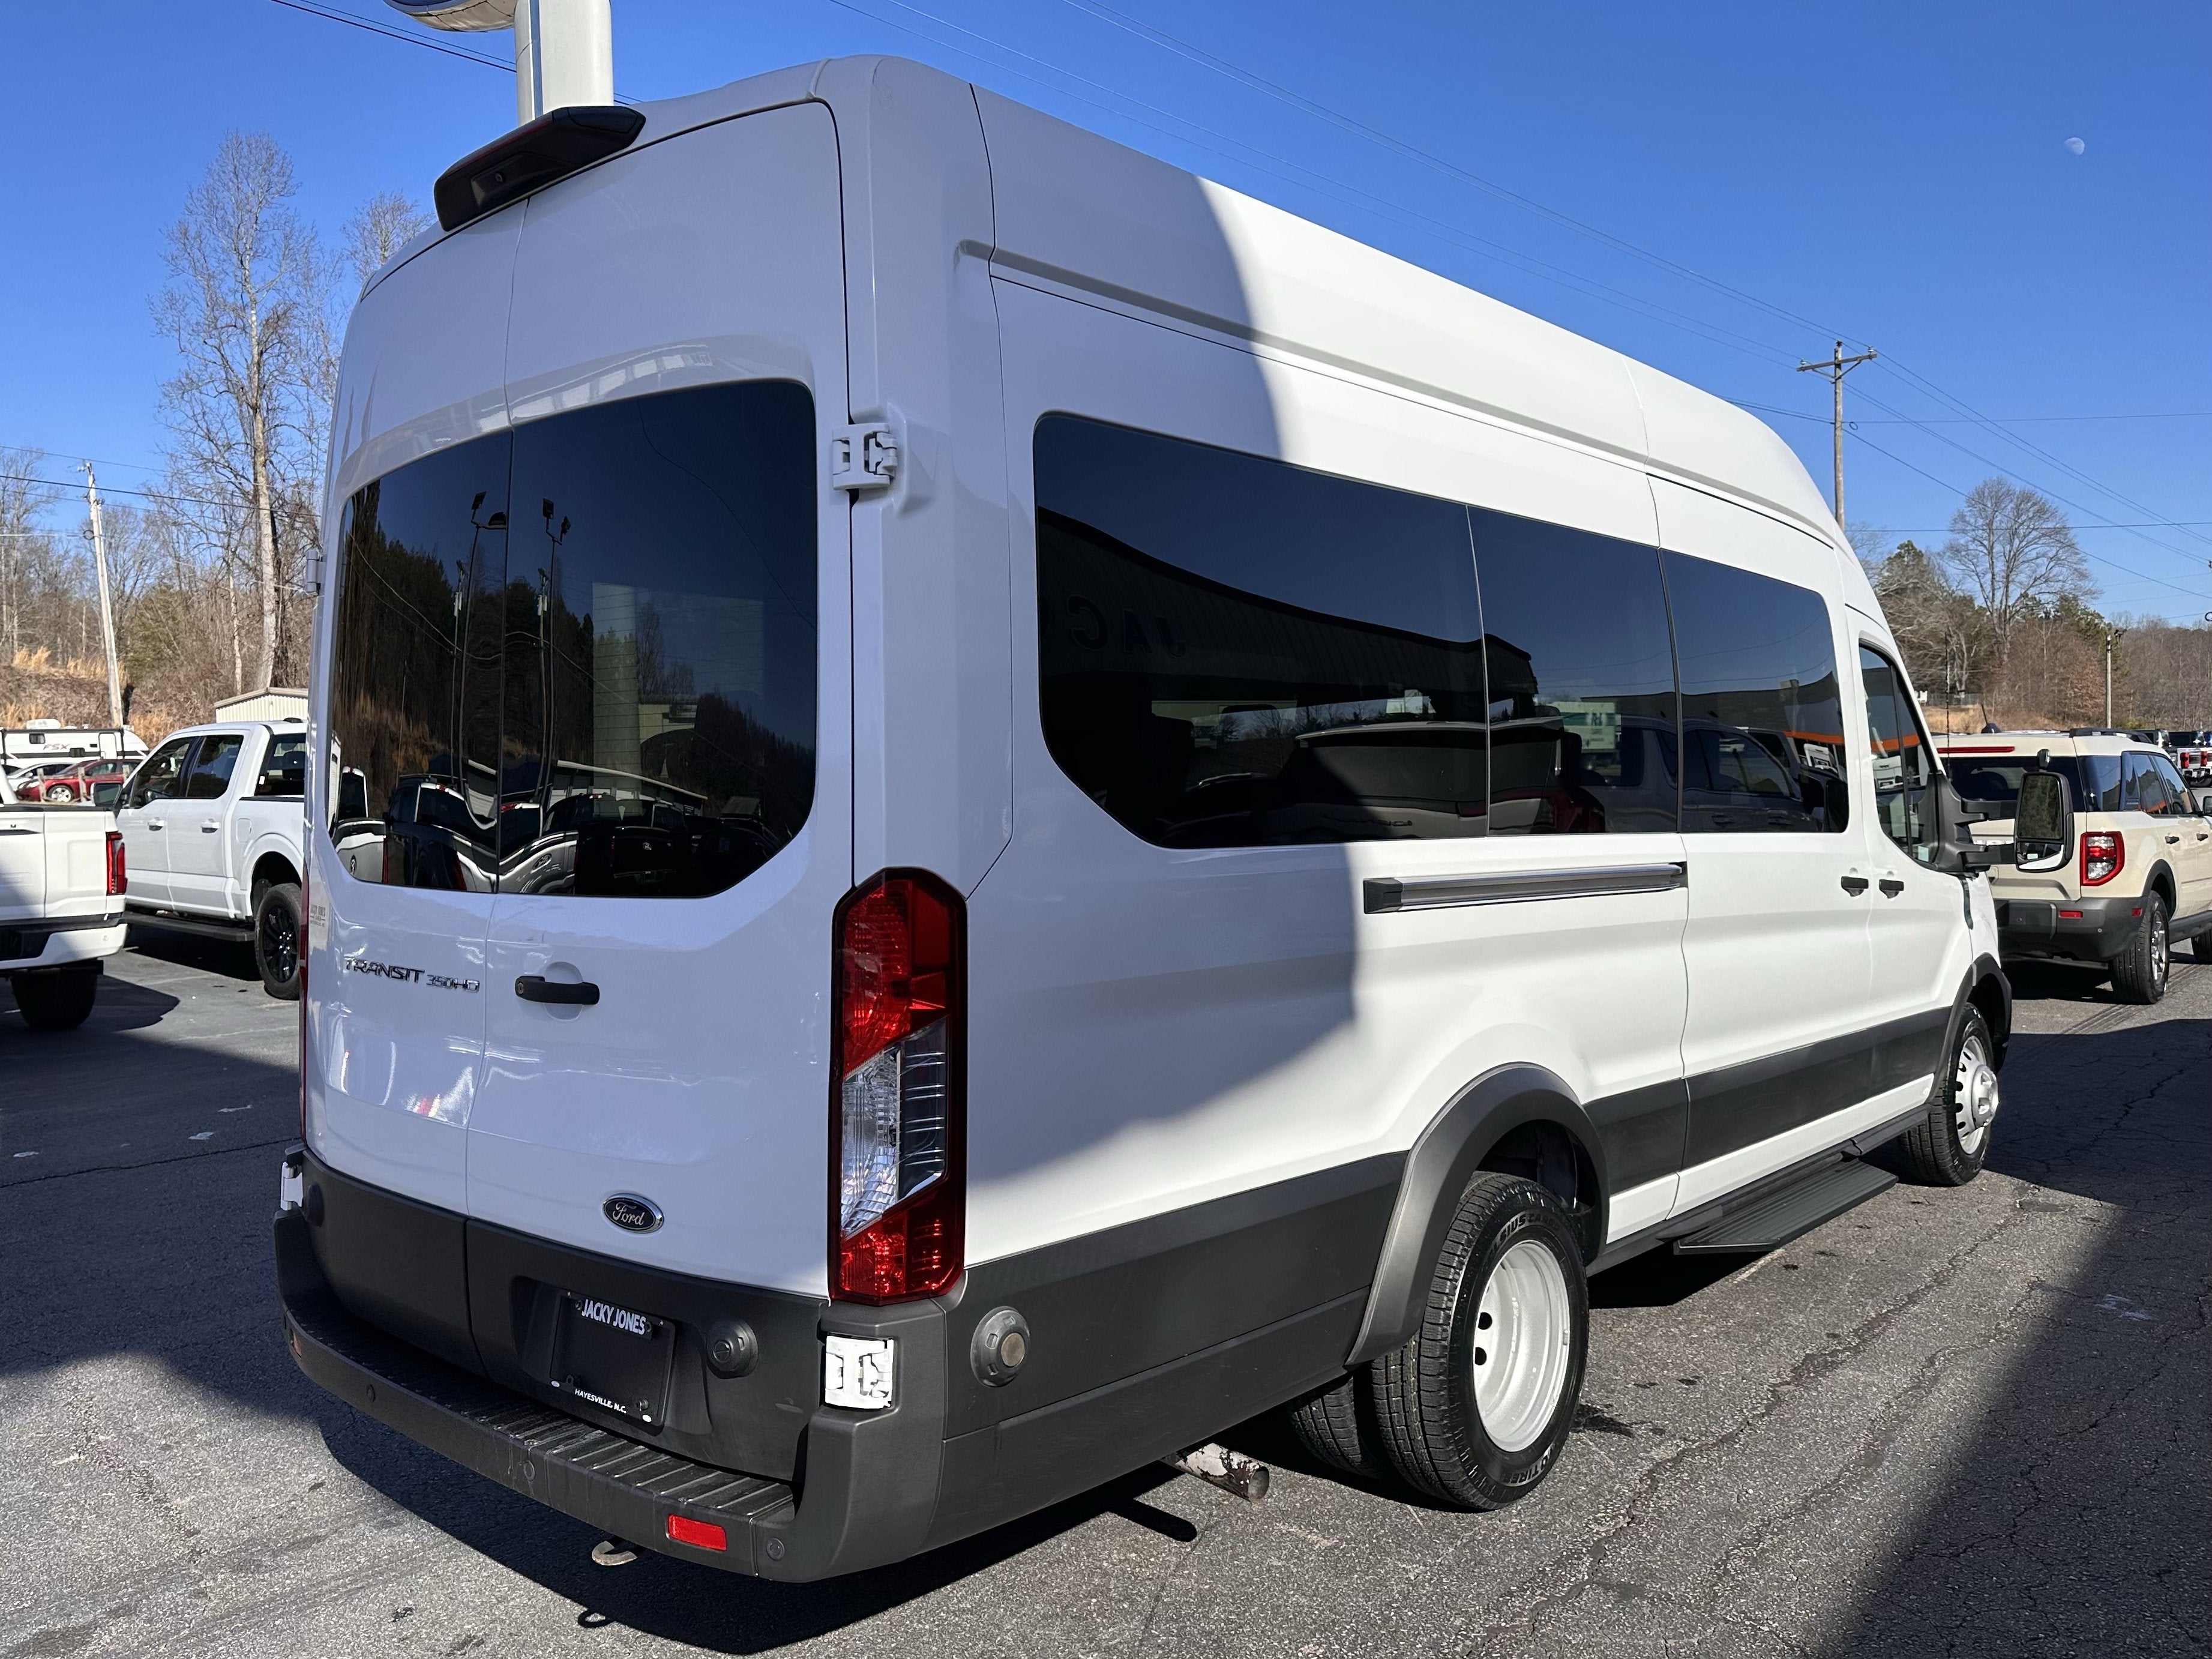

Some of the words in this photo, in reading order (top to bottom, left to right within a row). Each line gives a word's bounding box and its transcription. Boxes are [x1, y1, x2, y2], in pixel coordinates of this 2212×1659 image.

[344, 957, 425, 983] TRANSIT
[426, 975, 480, 993] 350HD
[612, 1202, 645, 1226] Ford
[582, 1299, 614, 1325] JACKY
[613, 1308, 646, 1335] JONES
[614, 1403, 627, 1414] N.C.
